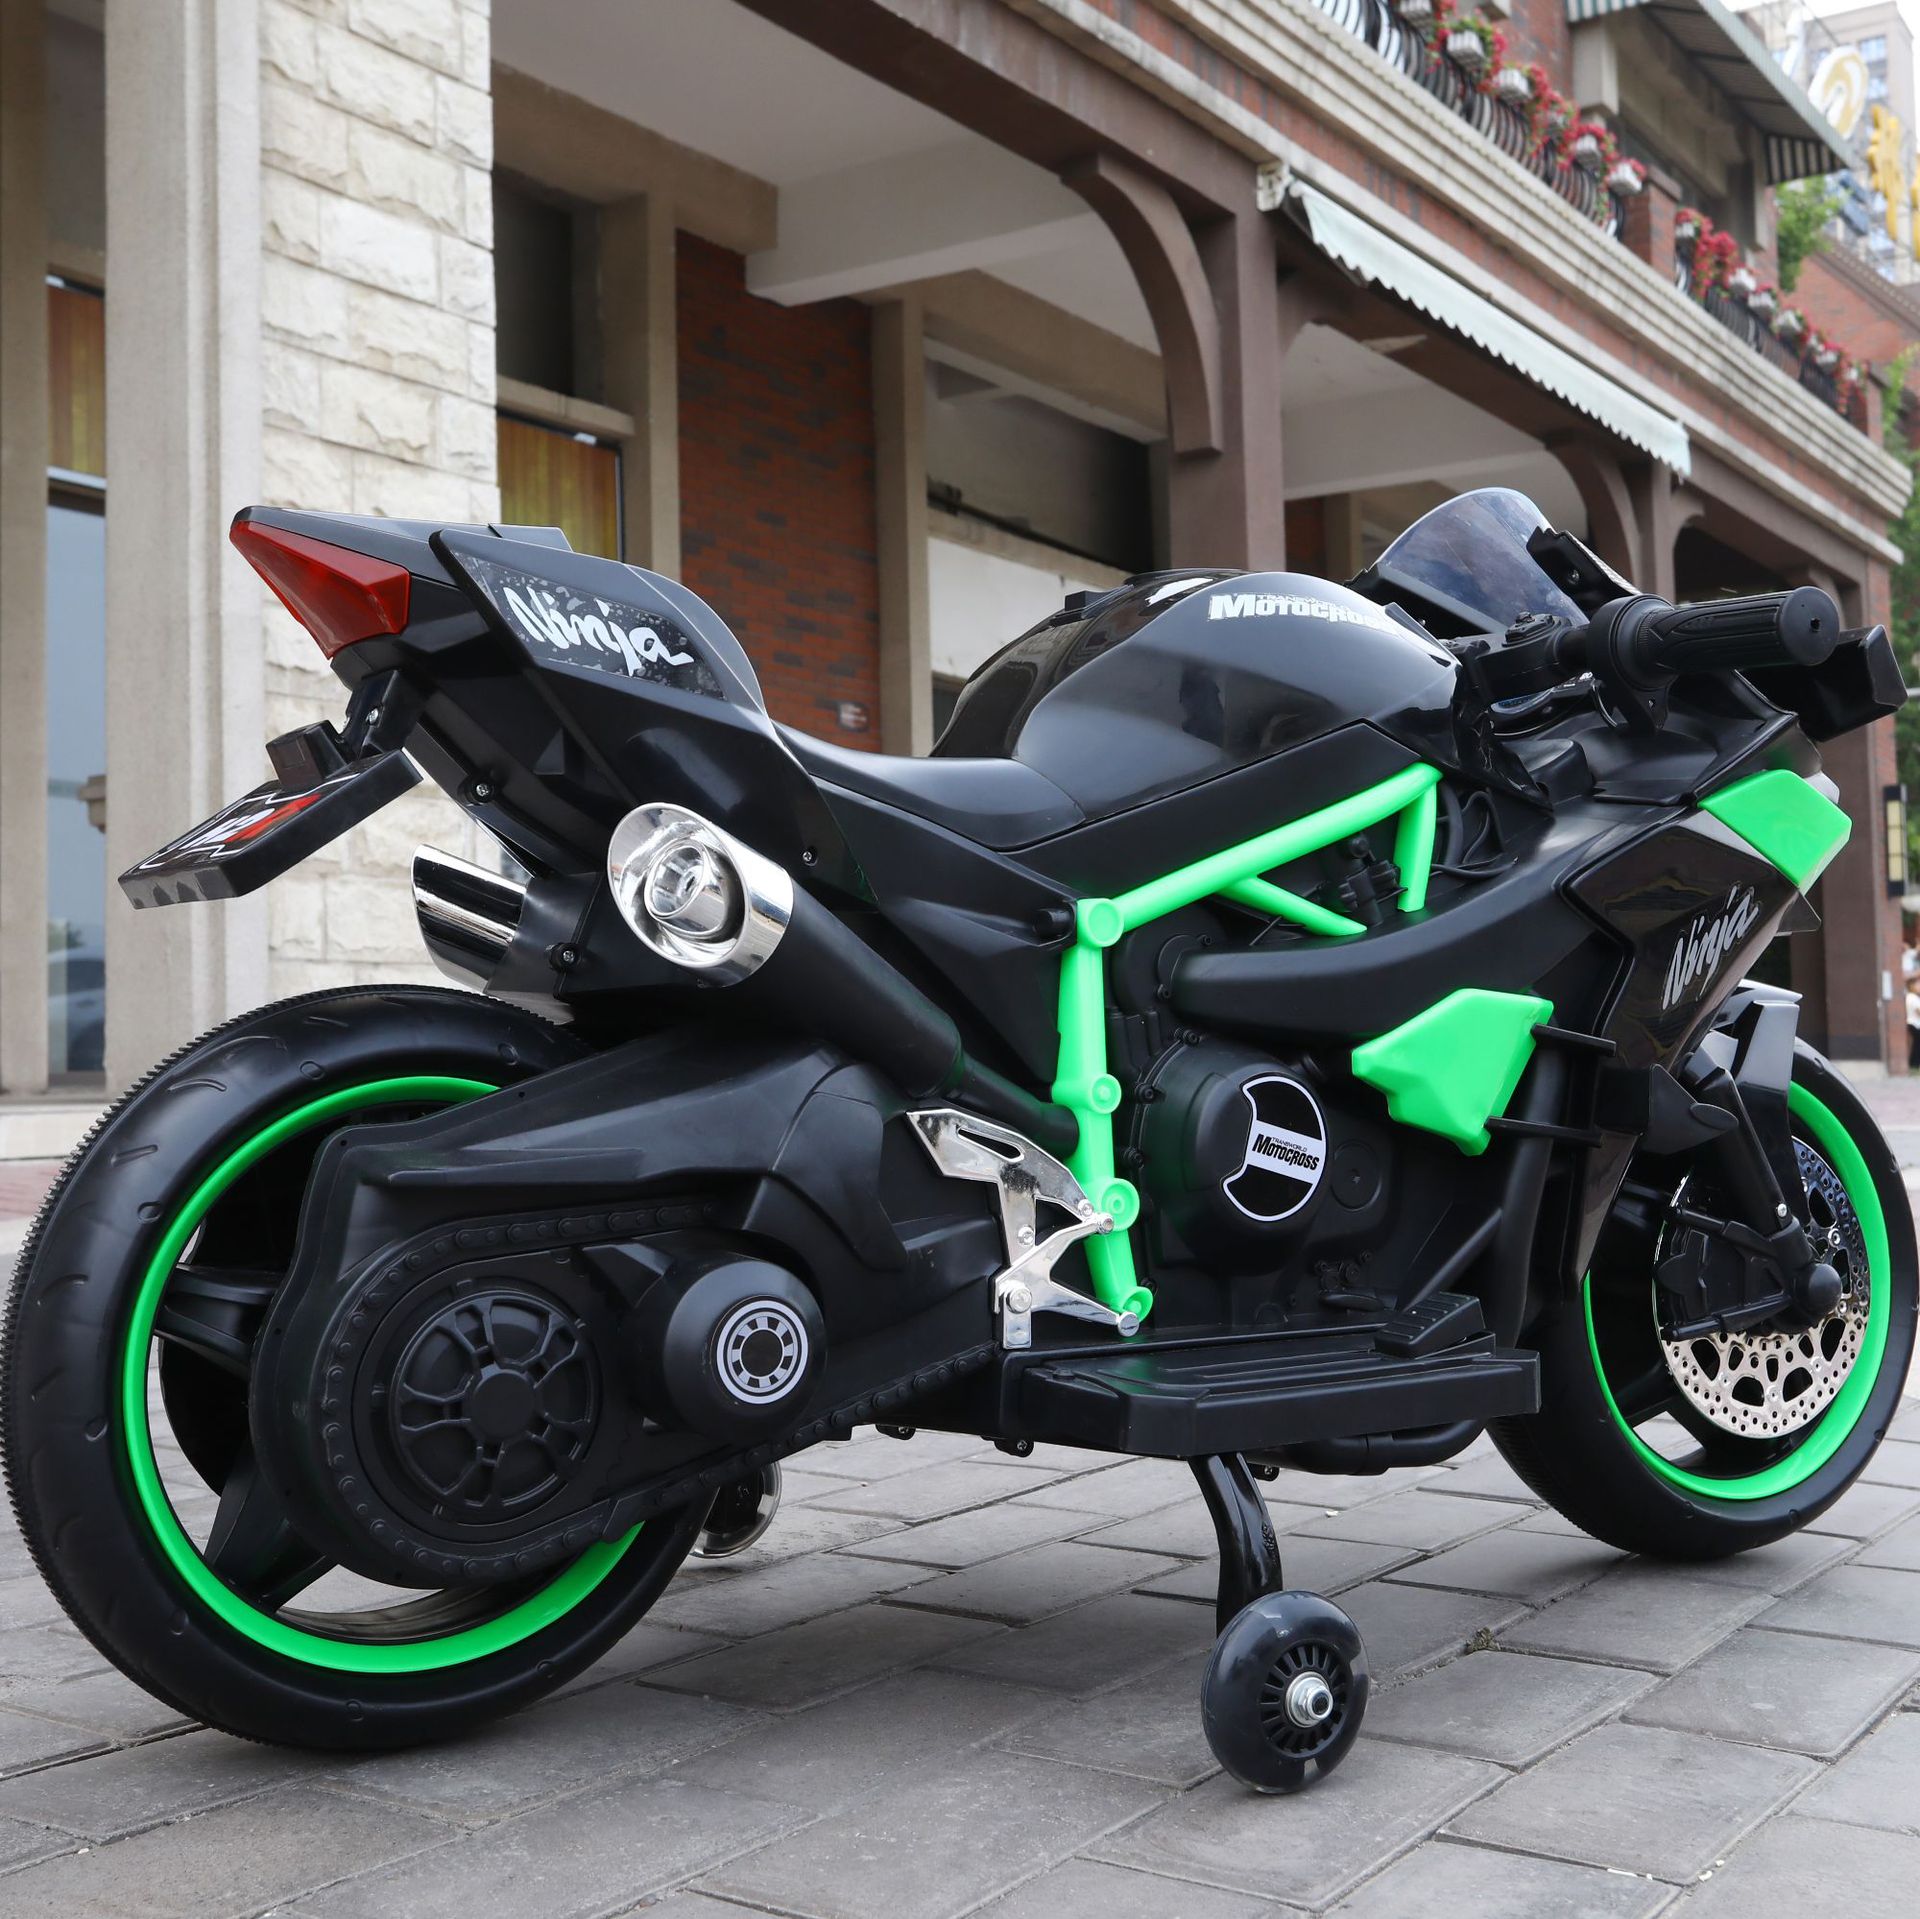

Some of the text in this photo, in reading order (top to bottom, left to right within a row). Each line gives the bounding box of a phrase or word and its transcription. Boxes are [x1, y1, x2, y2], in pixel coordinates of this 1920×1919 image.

[502, 586, 695, 677] Ninja
[1208, 593, 1390, 631] MOTOCRO
[1662, 885, 1759, 1011] Ninja
[1251, 1133, 1320, 1171] MOTOCROSS
